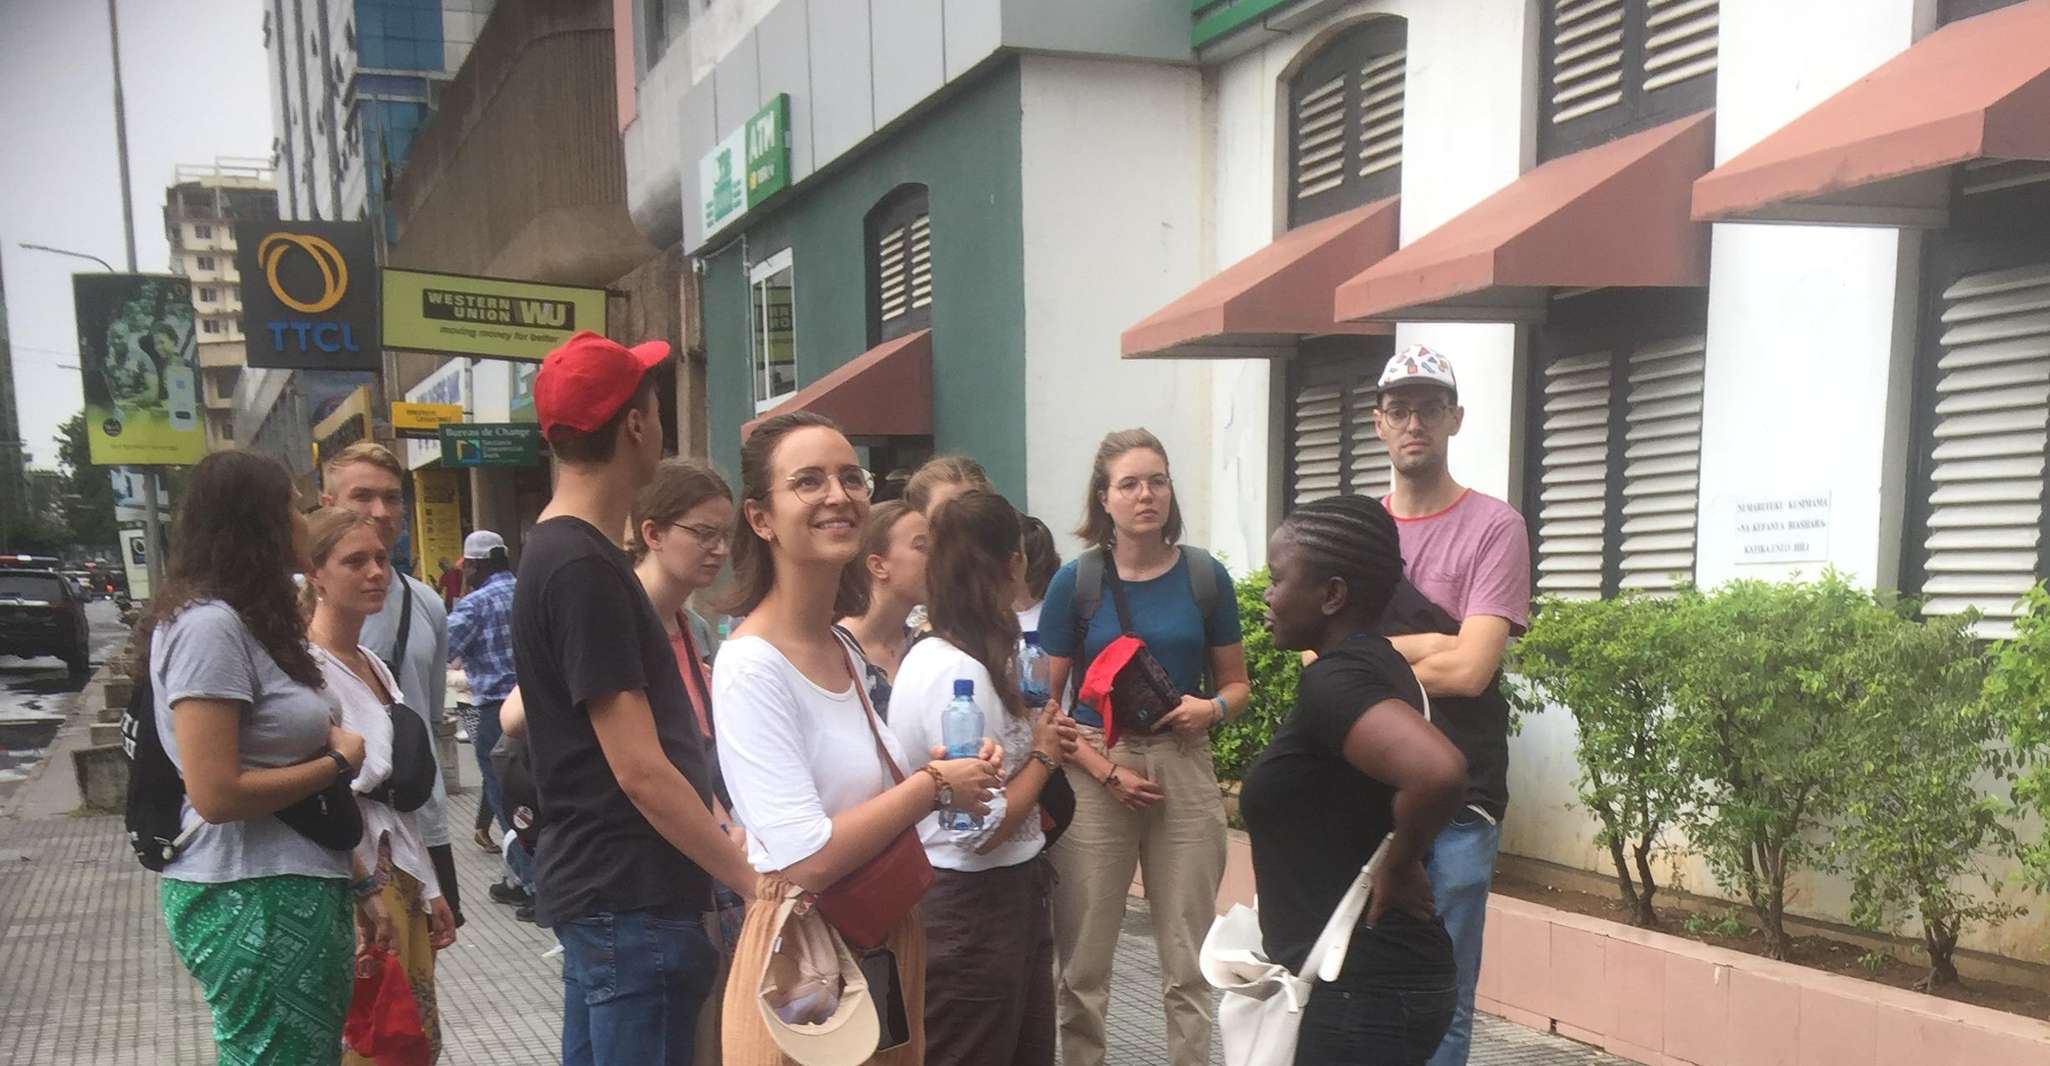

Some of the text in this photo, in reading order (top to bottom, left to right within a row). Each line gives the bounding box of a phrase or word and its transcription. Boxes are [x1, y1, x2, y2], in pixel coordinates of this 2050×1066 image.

[748, 110, 775, 165] ATM
[426, 291, 510, 310] WESTERN
[454, 306, 510, 323] UNION
[519, 300, 567, 327] WU
[265, 320, 360, 353] TTCL
[440, 326, 559, 343] moving money for better
[445, 427, 480, 438] Bureau
[481, 427, 493, 437] de
[495, 427, 531, 439] Change
